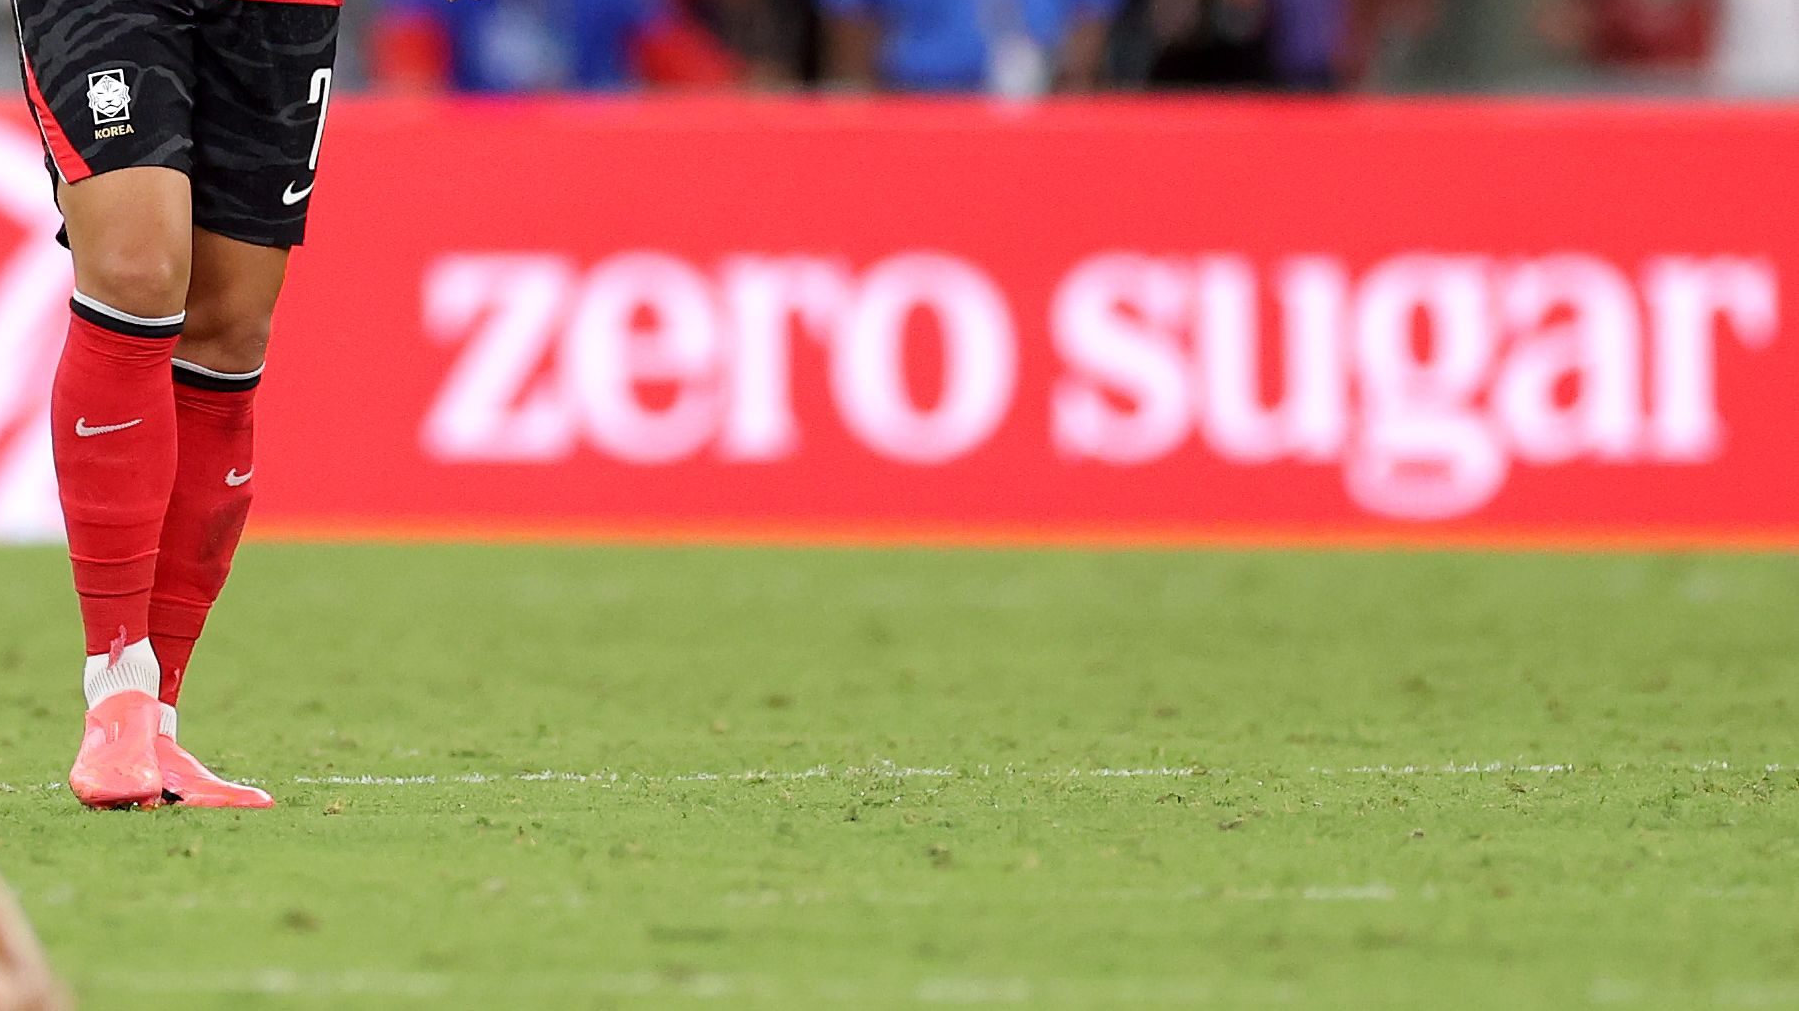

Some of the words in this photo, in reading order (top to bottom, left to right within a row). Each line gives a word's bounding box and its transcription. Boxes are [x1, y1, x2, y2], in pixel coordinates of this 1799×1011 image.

[94, 124, 134, 139] KOREA
[306, 67, 331, 170] 7
[419, 248, 1018, 464] zero
[1047, 248, 1780, 522] sugar
